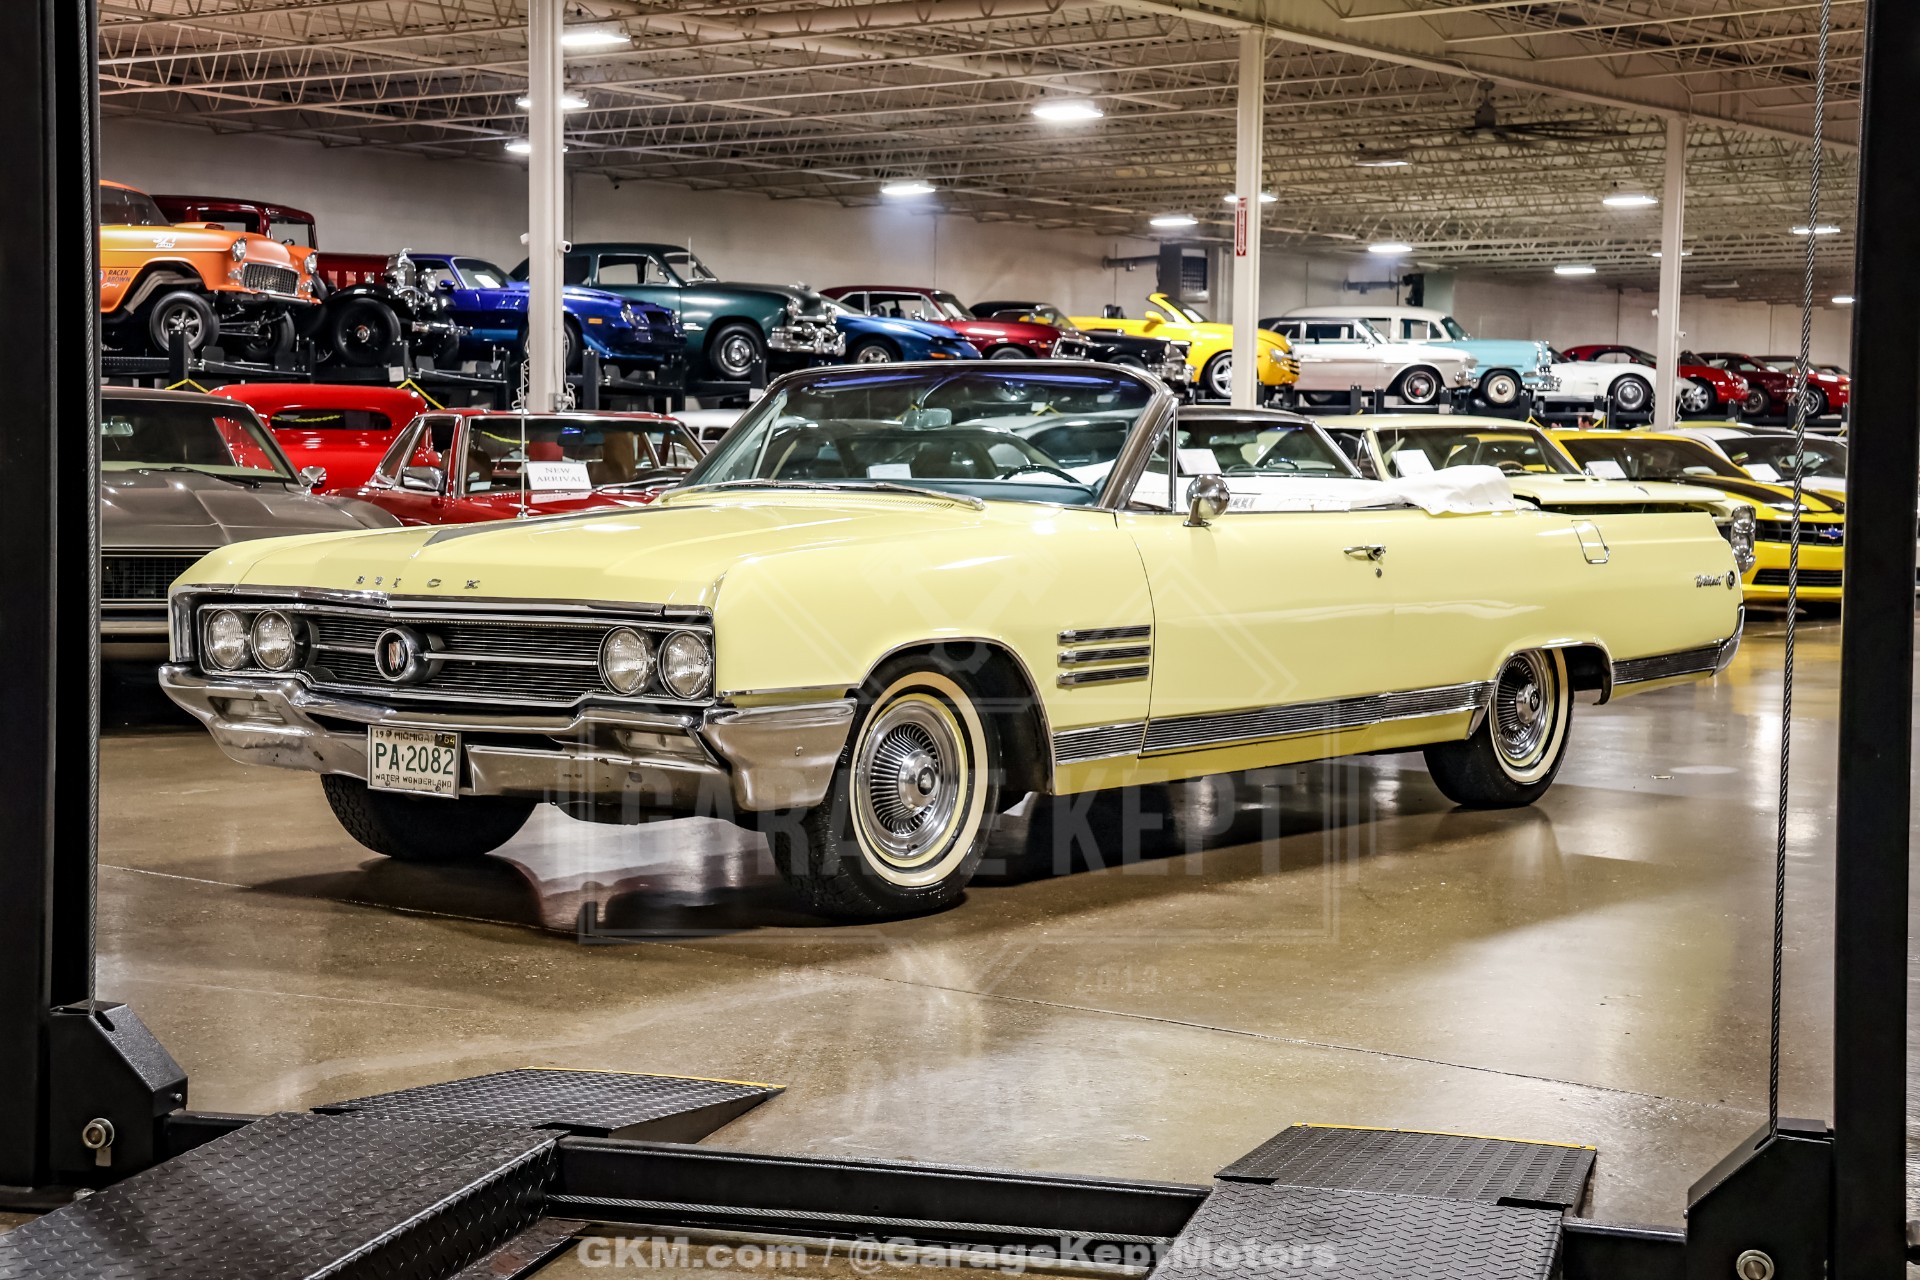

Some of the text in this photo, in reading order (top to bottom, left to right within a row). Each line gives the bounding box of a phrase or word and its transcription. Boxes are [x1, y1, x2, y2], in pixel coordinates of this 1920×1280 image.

[356, 575, 480, 589] BUICK
[375, 773, 452, 789] WATER WONDERLAND
